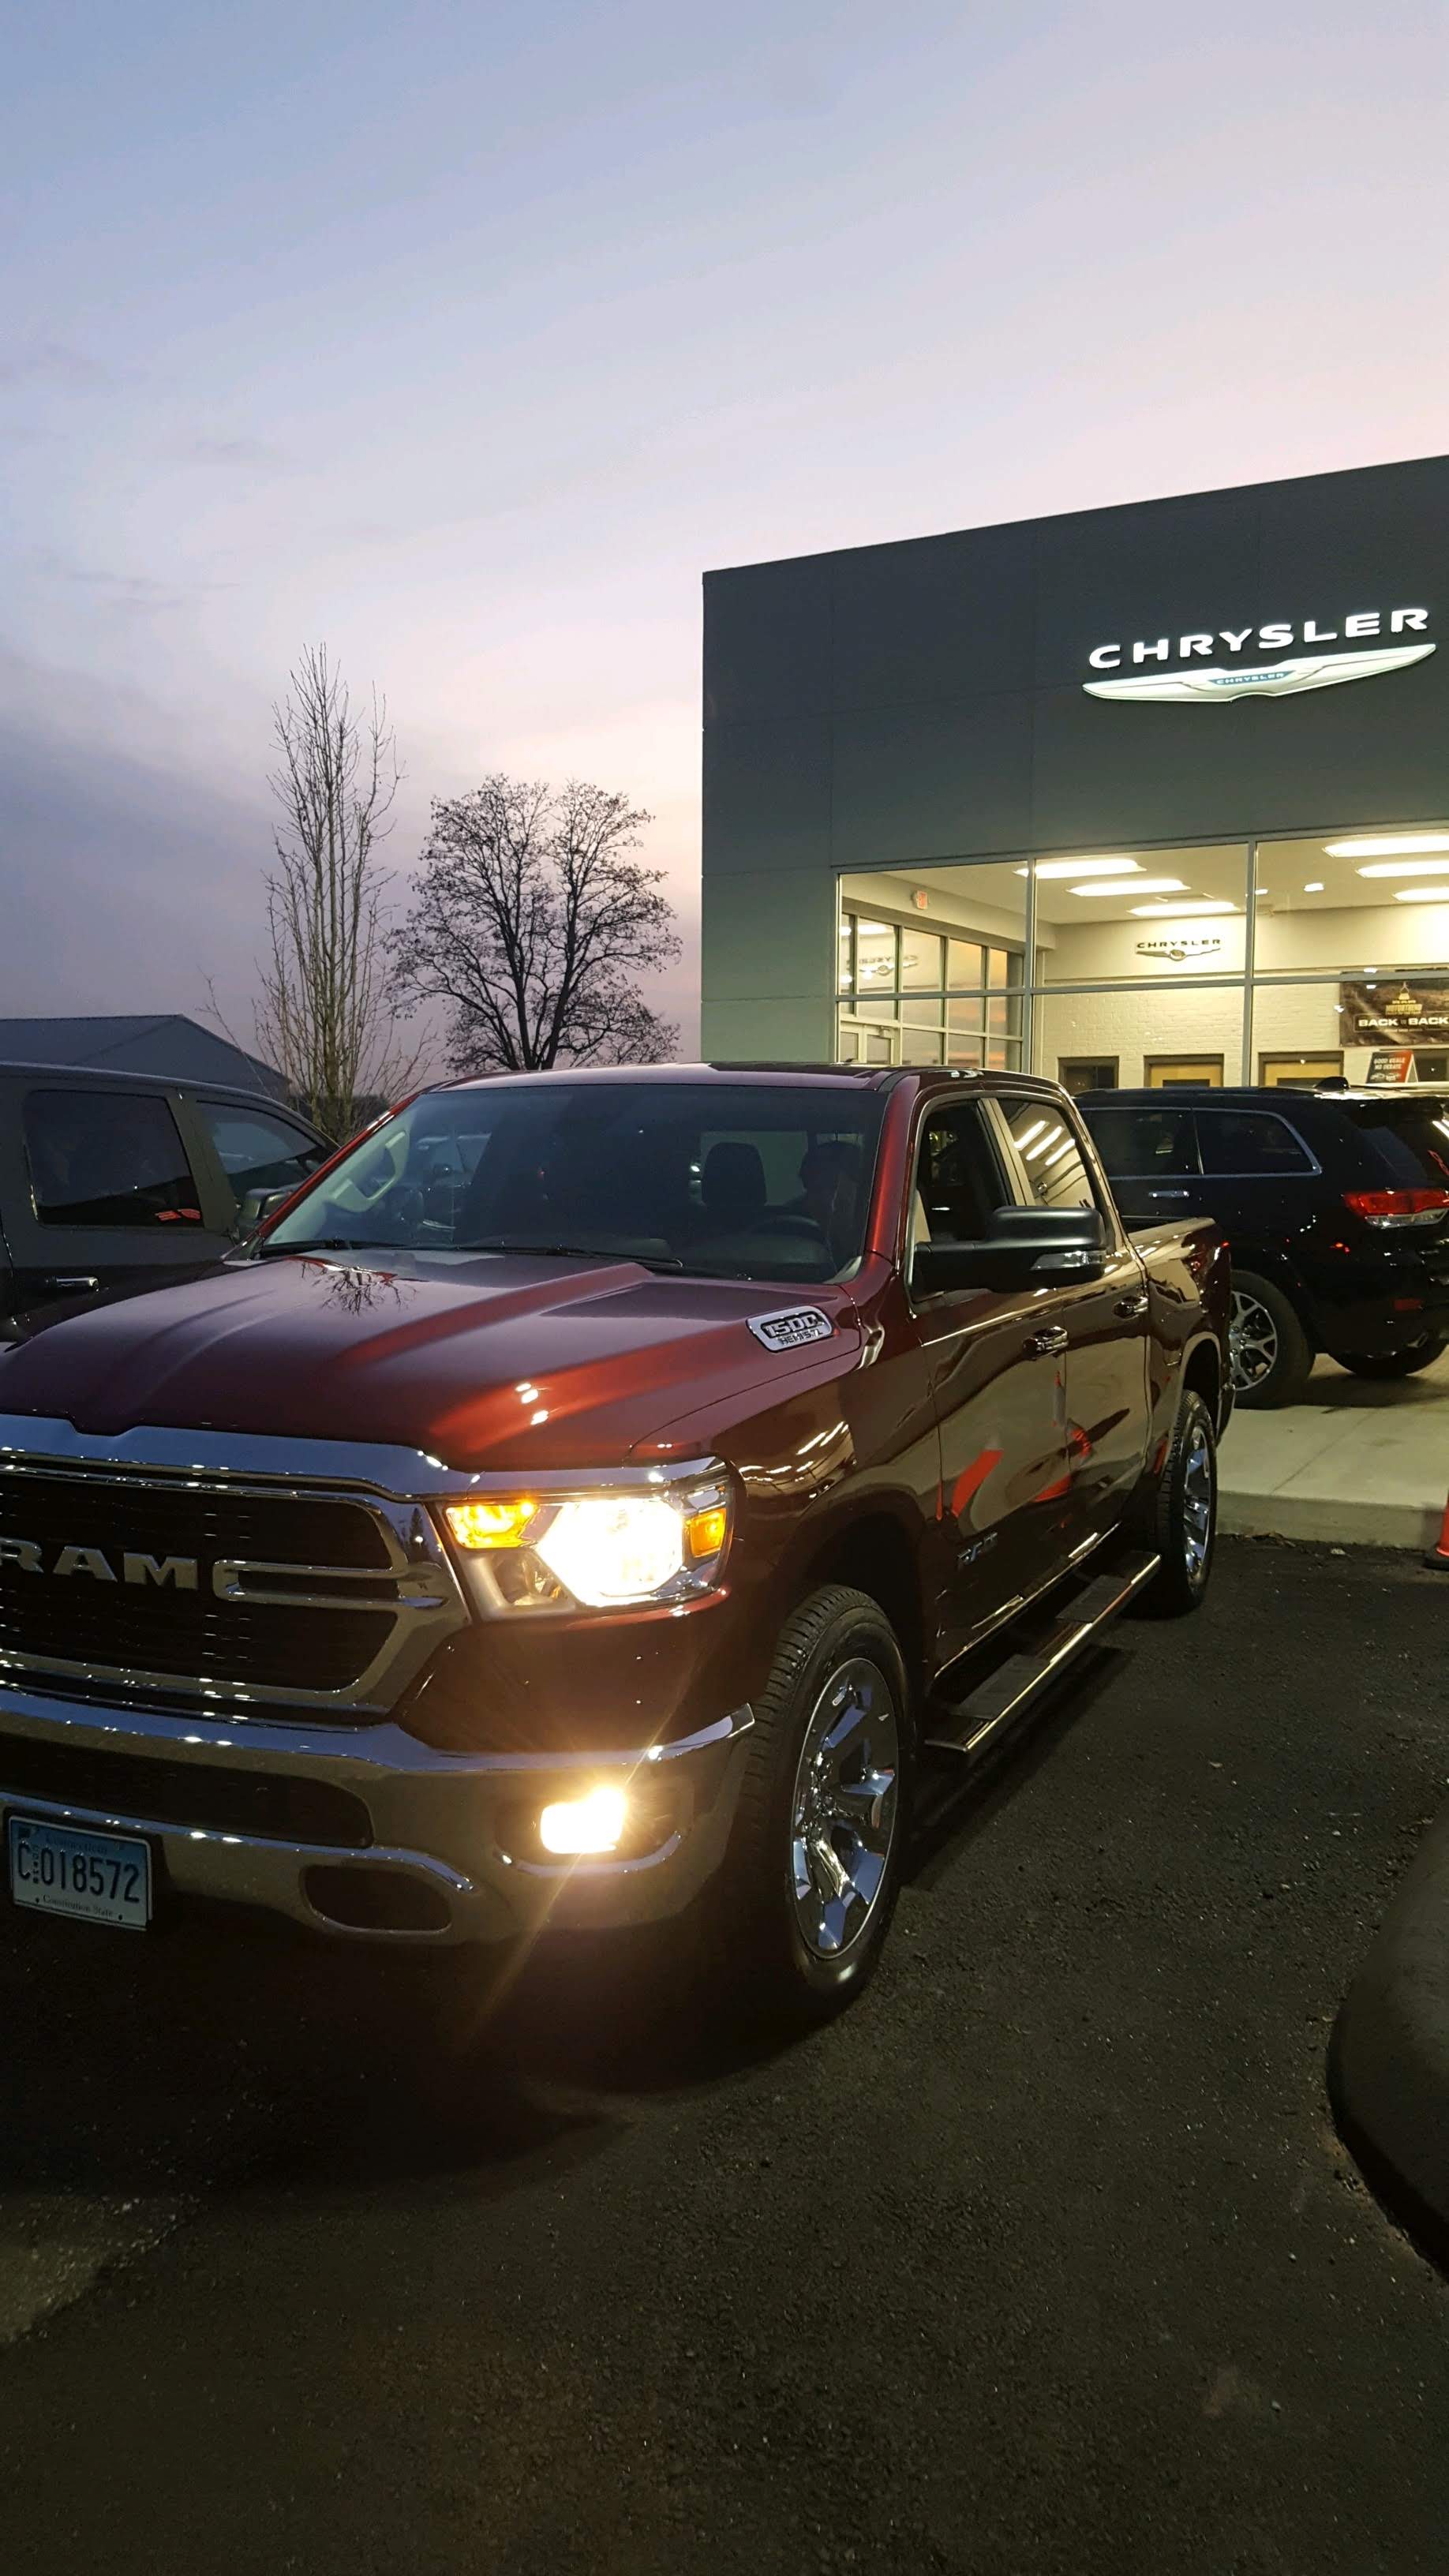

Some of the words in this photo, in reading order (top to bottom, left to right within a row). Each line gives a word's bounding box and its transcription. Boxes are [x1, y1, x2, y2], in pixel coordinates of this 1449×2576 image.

[1088, 608, 1428, 669] CHRYSLER
[1216, 672, 1285, 684] CHRYSLER
[1136, 938, 1221, 949] CHRYSLER
[1358, 1018, 1398, 1027] BACK
[1408, 1017, 1449, 1025] BACK
[763, 1313, 819, 1337] 1500
[0, 1538, 197, 1589] RAM
